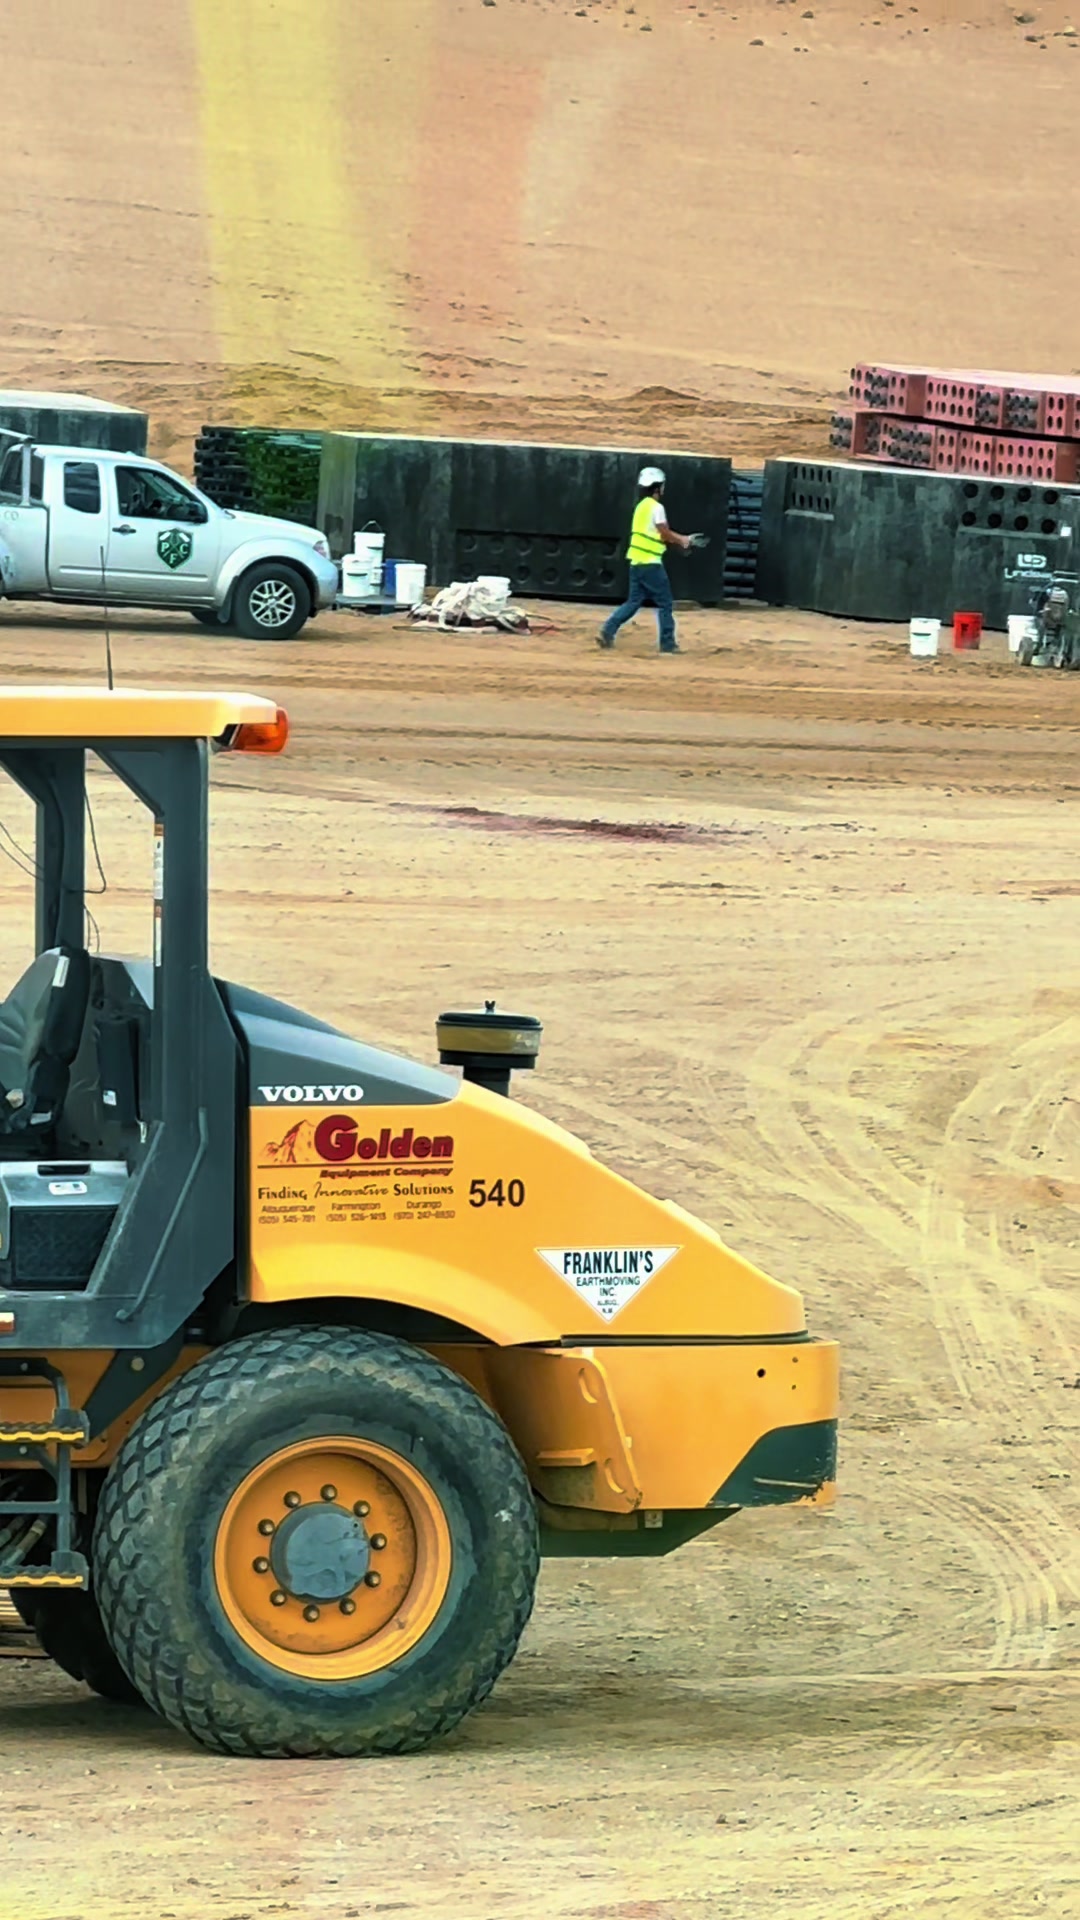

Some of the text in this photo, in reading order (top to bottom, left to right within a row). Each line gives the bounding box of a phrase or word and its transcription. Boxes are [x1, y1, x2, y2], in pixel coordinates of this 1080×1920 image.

[257, 1084, 364, 1102] VOLVO
[314, 1114, 454, 1162] Golden
[320, 1167, 453, 1180] Equipment Company
[469, 1178, 525, 1208] 540
[564, 1250, 653, 1275] FRANKLIN'S
[576, 1276, 641, 1287] EARTHMOVING
